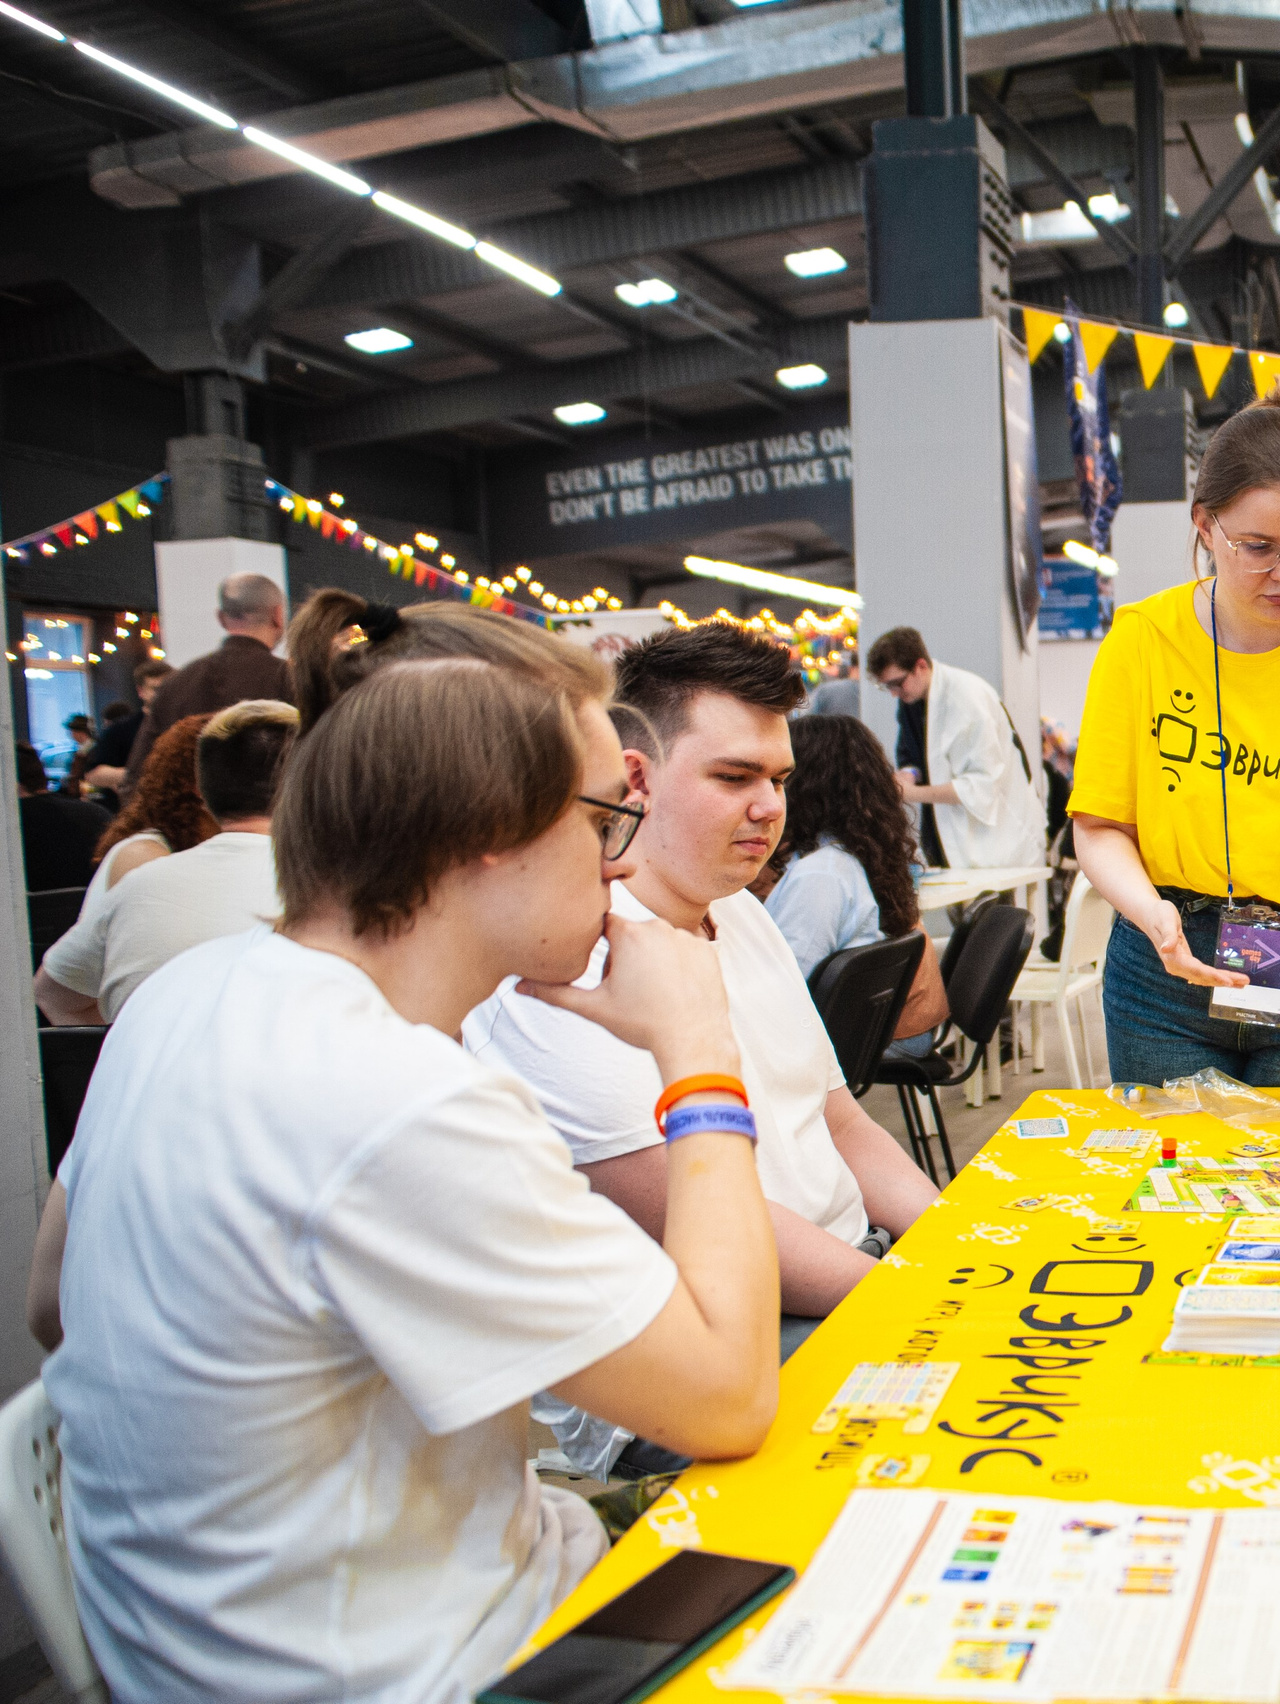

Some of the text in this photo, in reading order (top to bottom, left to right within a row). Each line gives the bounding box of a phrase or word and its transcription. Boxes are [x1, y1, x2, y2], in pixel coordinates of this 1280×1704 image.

[547, 426, 851, 496] EVEN THE GREATEST WAS ON
[549, 491, 615, 526] DON'T
[619, 486, 649, 515] BE
[653, 474, 735, 509] AFRAID
[736, 468, 768, 494] TO
[770, 459, 827, 489] TAKE
[938, 1303, 1133, 1474] Эврикус
